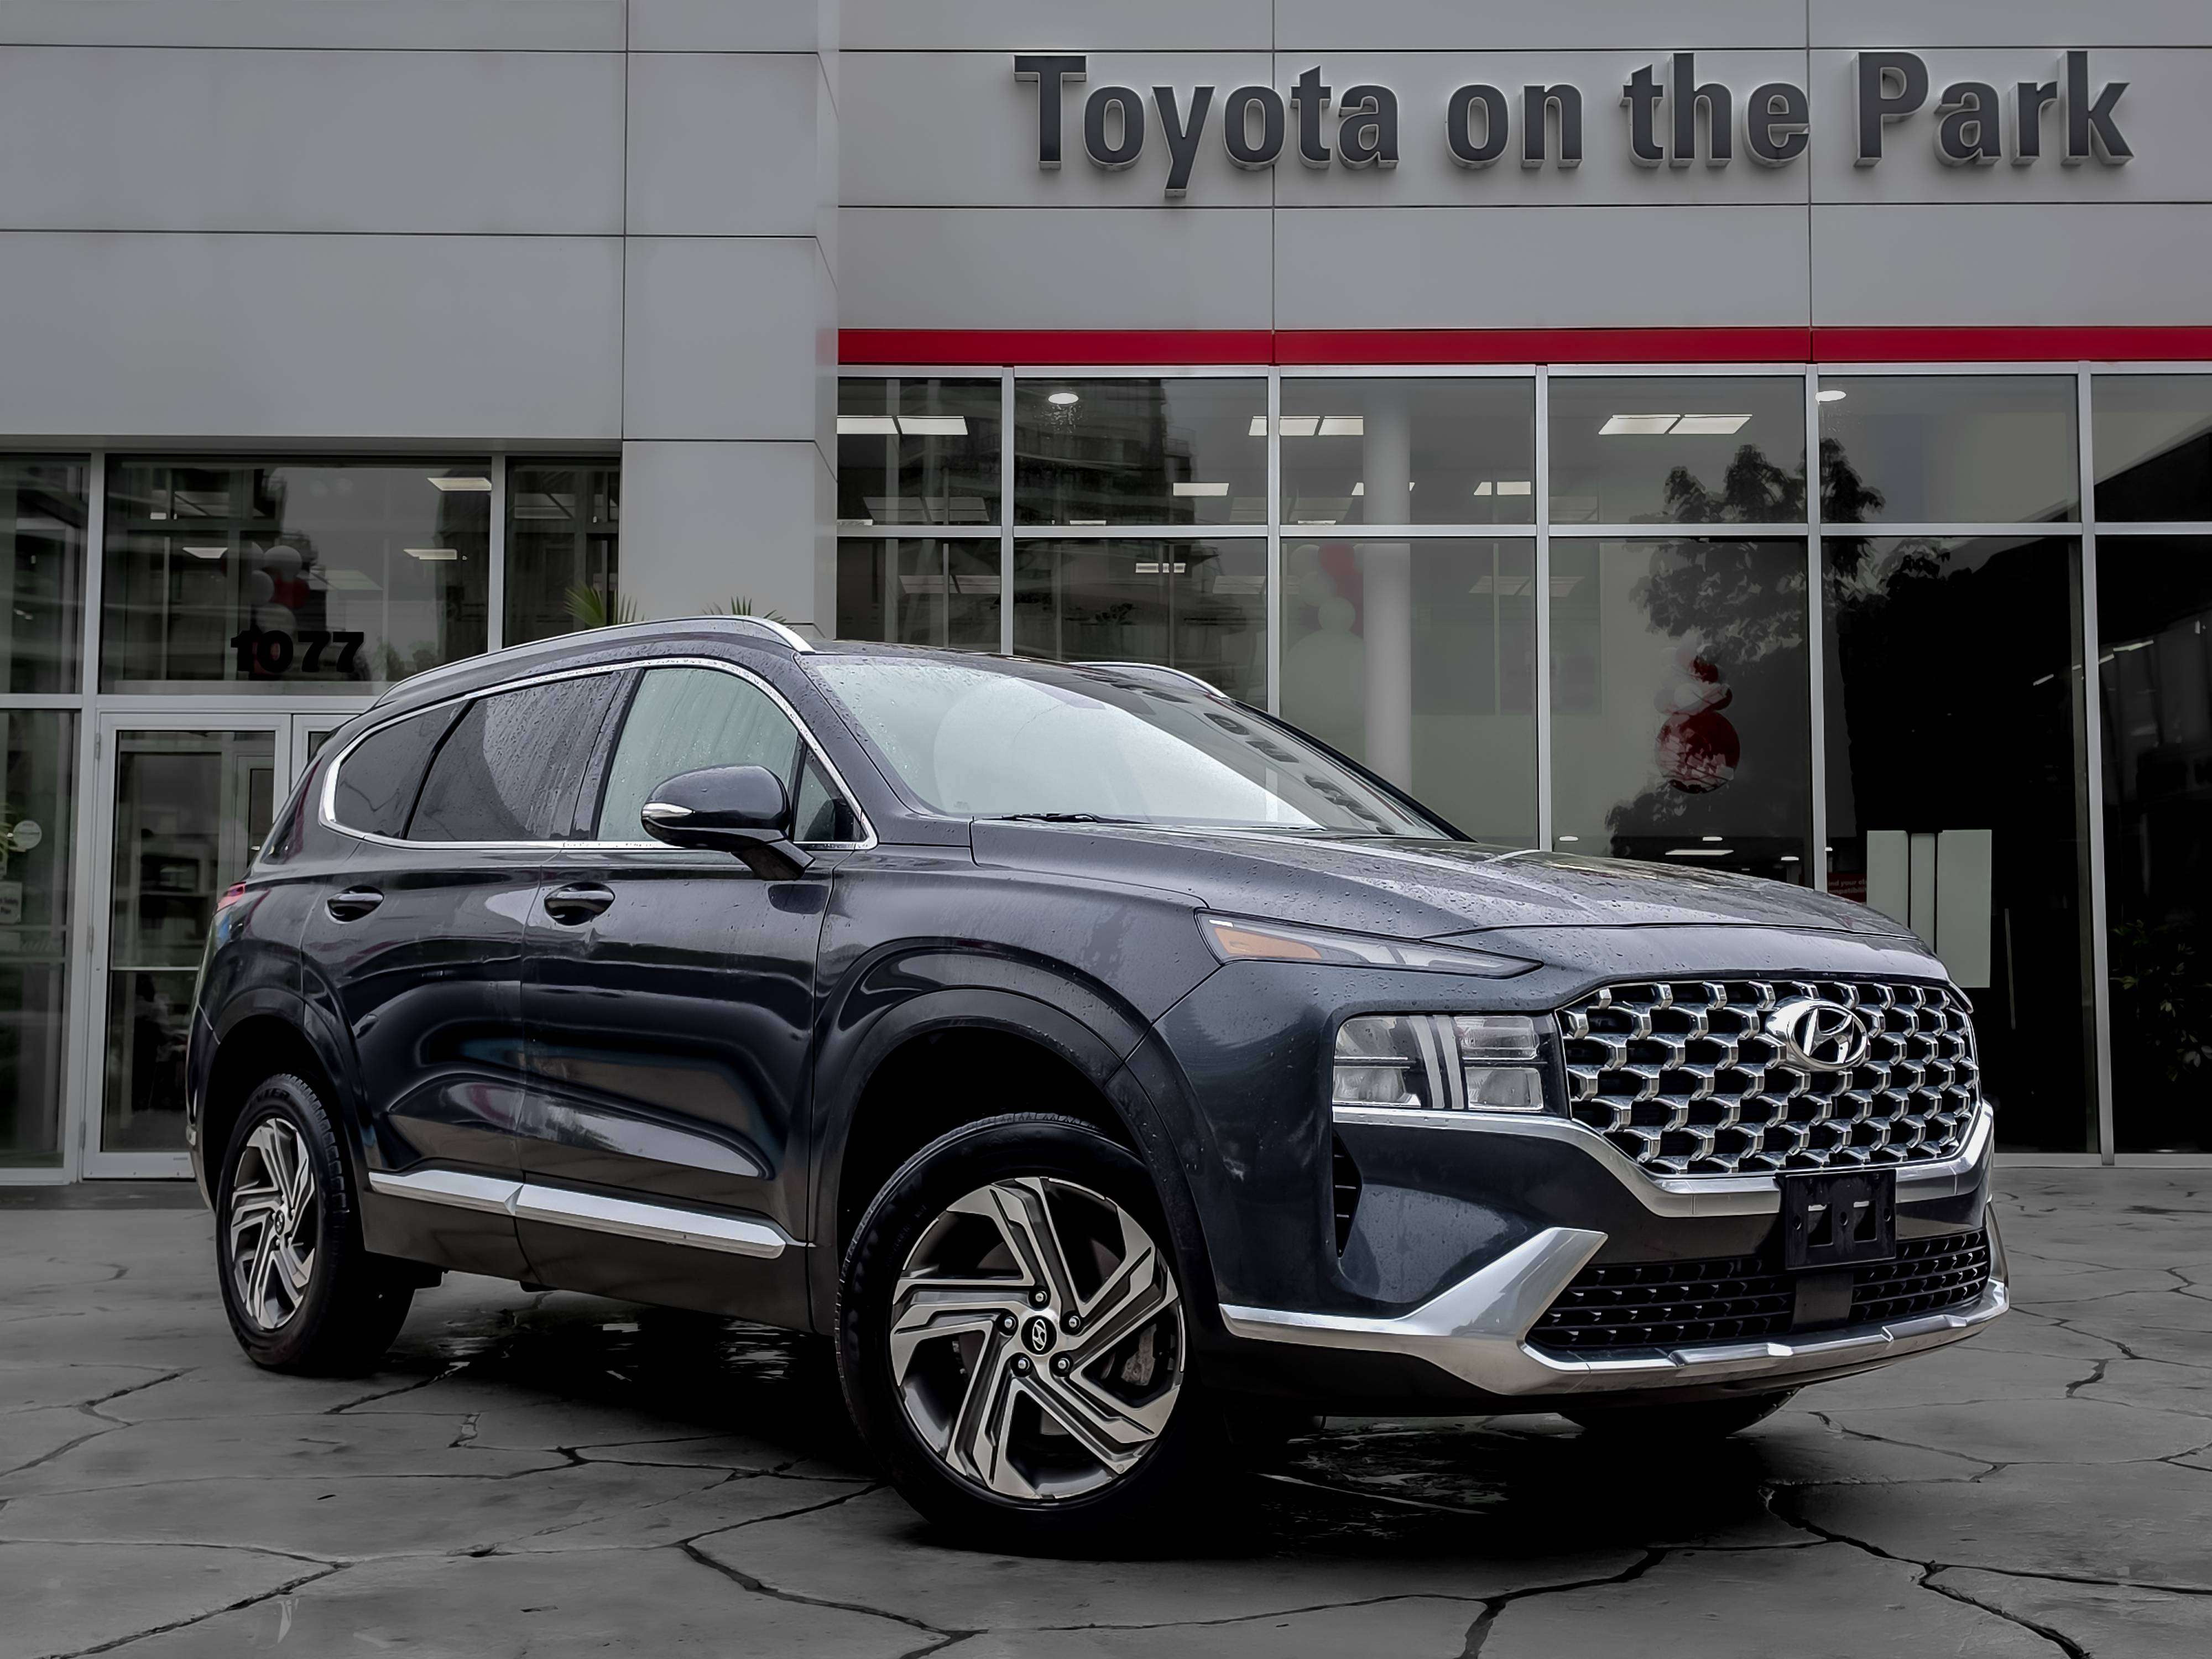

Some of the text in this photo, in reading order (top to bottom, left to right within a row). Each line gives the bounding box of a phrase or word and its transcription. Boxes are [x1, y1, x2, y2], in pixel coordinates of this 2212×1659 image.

[1014, 50, 2133, 195] Toyota on the Park
[231, 630, 364, 673] 1077
